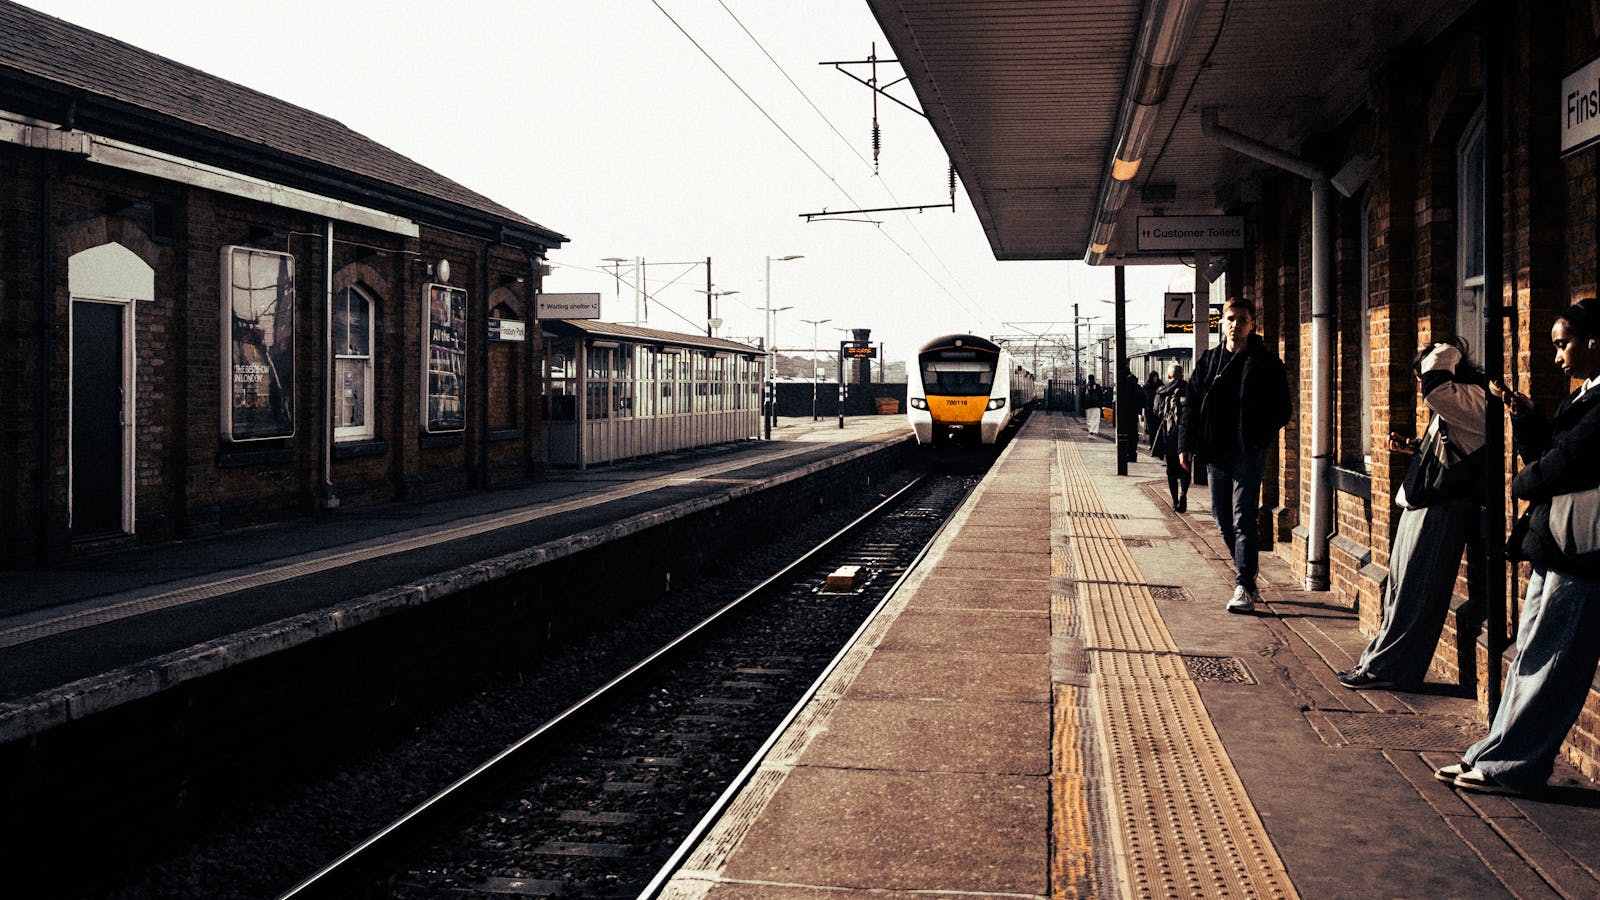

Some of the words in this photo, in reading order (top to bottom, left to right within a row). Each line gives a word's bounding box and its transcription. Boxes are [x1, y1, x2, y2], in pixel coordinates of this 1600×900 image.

[1567, 77, 1600, 129] Fins
[1153, 228, 1204, 238] Customer
[1207, 227, 1241, 238] Toilets
[546, 303, 569, 311] Waiting
[1171, 297, 1186, 318] 7
[441, 329, 451, 342] the
